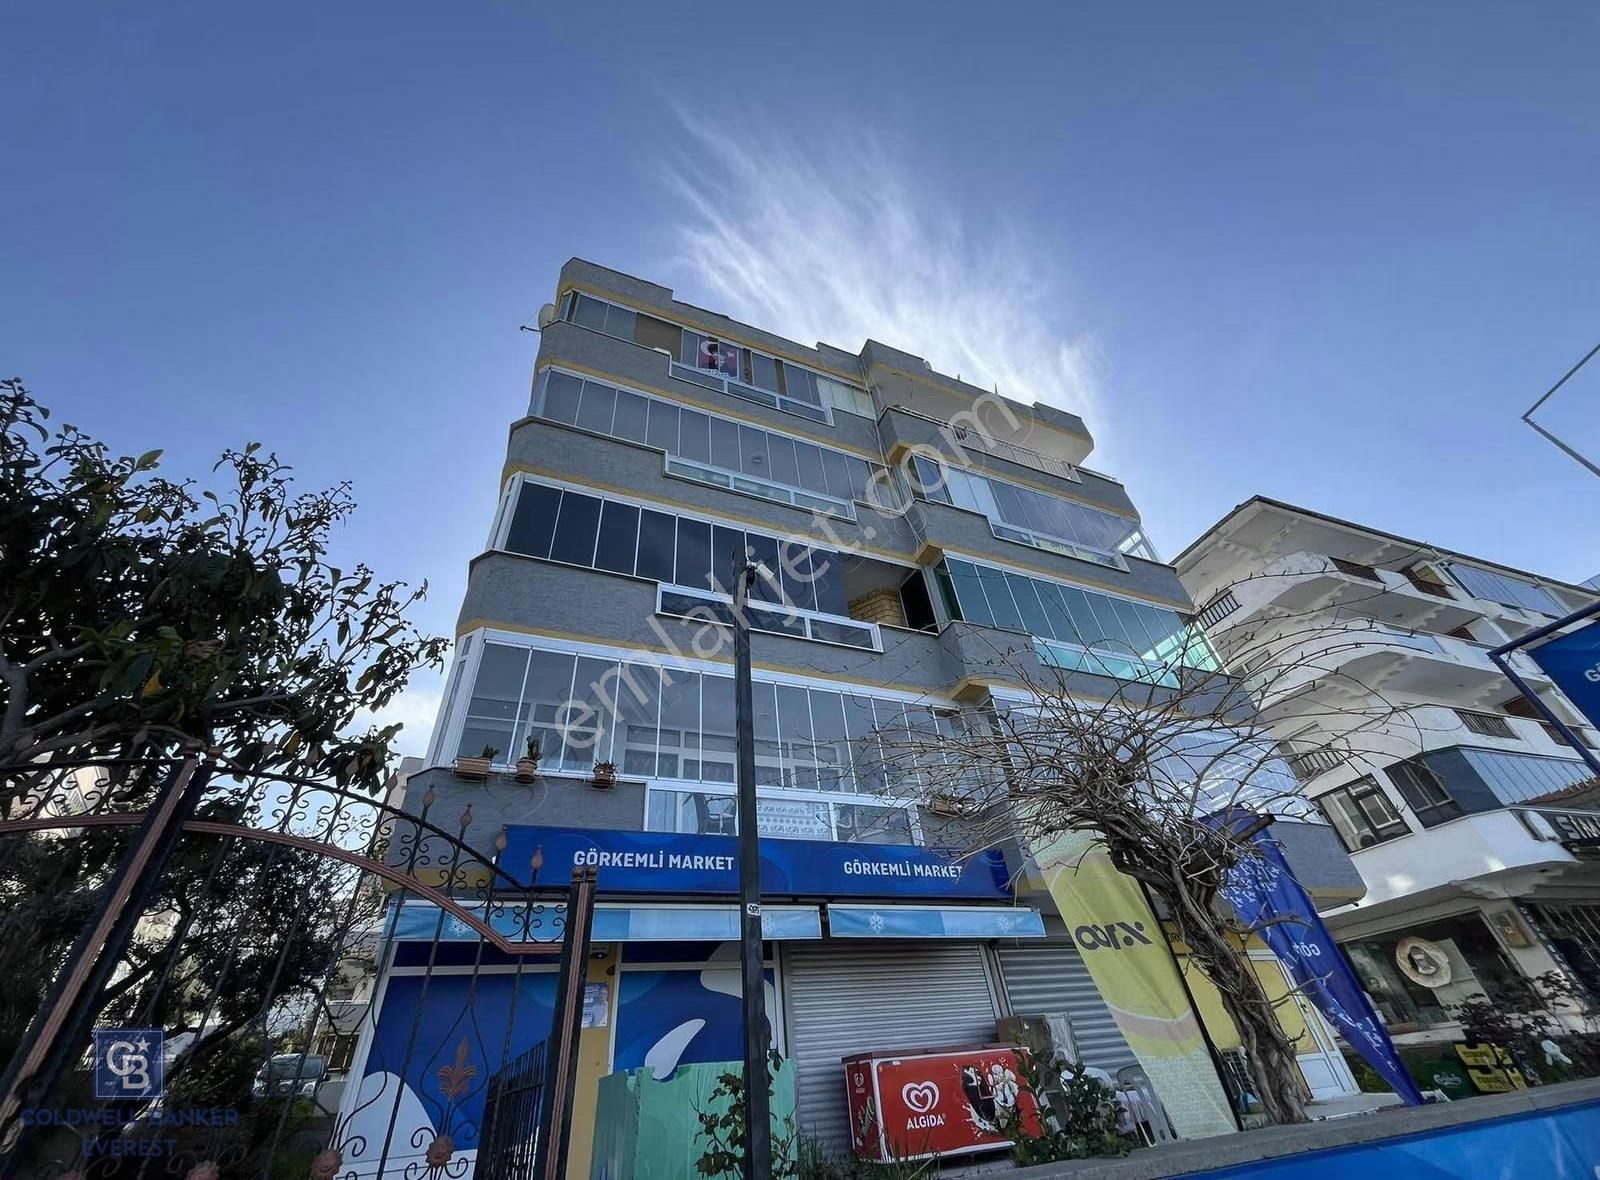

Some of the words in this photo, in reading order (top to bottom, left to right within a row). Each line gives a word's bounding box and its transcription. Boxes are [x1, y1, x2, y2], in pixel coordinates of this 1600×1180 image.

[574, 848, 664, 868] GÖRKEMLİ
[668, 854, 734, 870] MARKET
[844, 859, 911, 877] GÖRKEMLİ
[914, 864, 963, 878] MARKET
